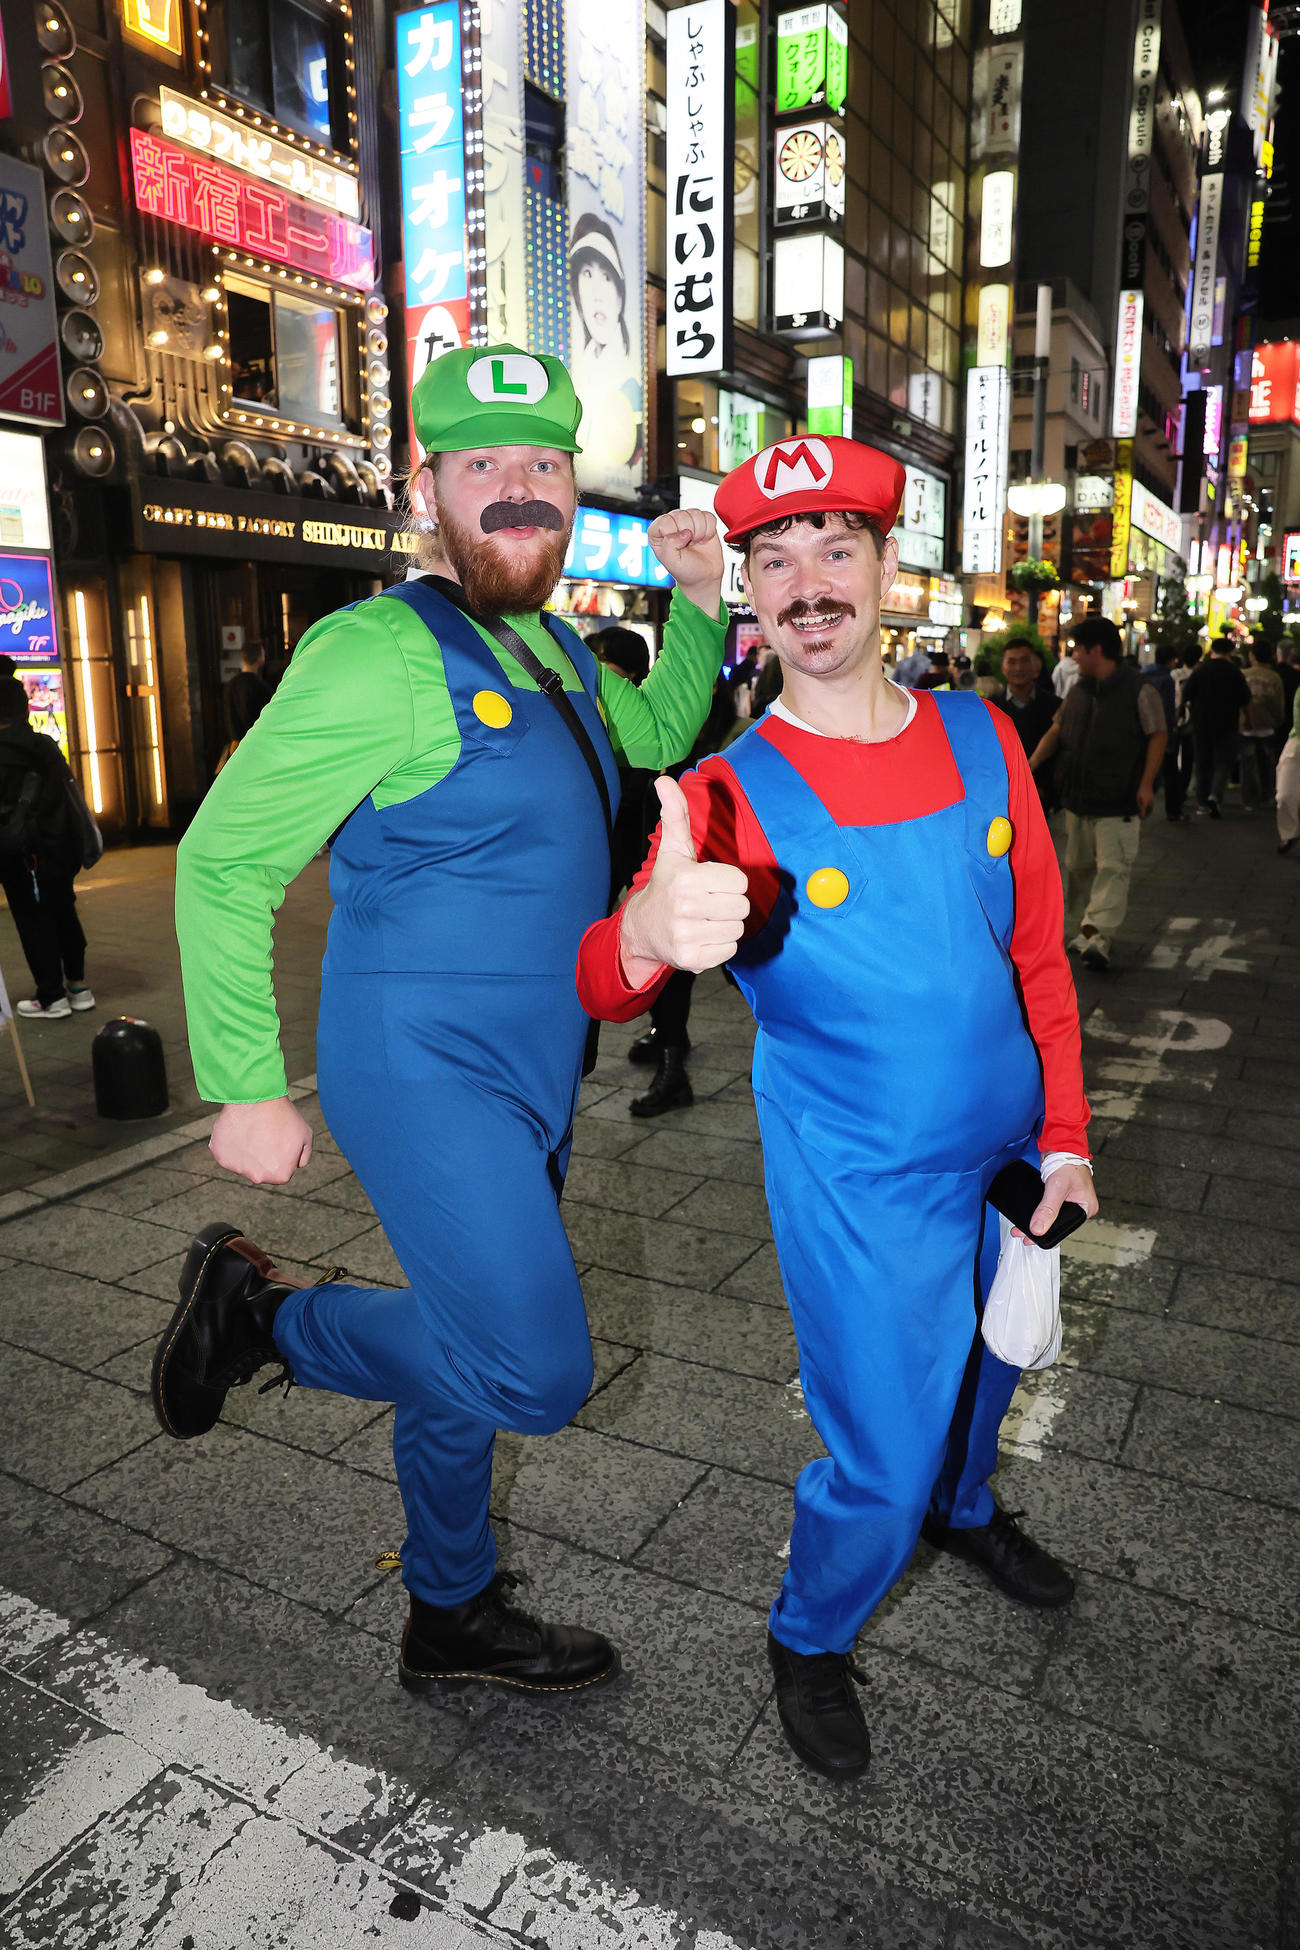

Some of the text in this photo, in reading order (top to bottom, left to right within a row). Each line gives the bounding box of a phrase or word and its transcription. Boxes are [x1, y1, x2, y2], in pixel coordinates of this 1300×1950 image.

[163, 99, 358, 215] クラフトビール工
[404, 13, 462, 303] カラオケ
[135, 137, 368, 284] 新宿エール
[674, 174, 715, 359] にいむら
[20, 388, 56, 414] B1F
[491, 360, 527, 395] L
[764, 441, 827, 490] M
[143, 504, 192, 526] CRAFT
[196, 511, 235, 531] BEER
[237, 515, 296, 538] FACTORY
[302, 520, 387, 551] SHINJUKU
[564, 514, 669, 580] ラオ
